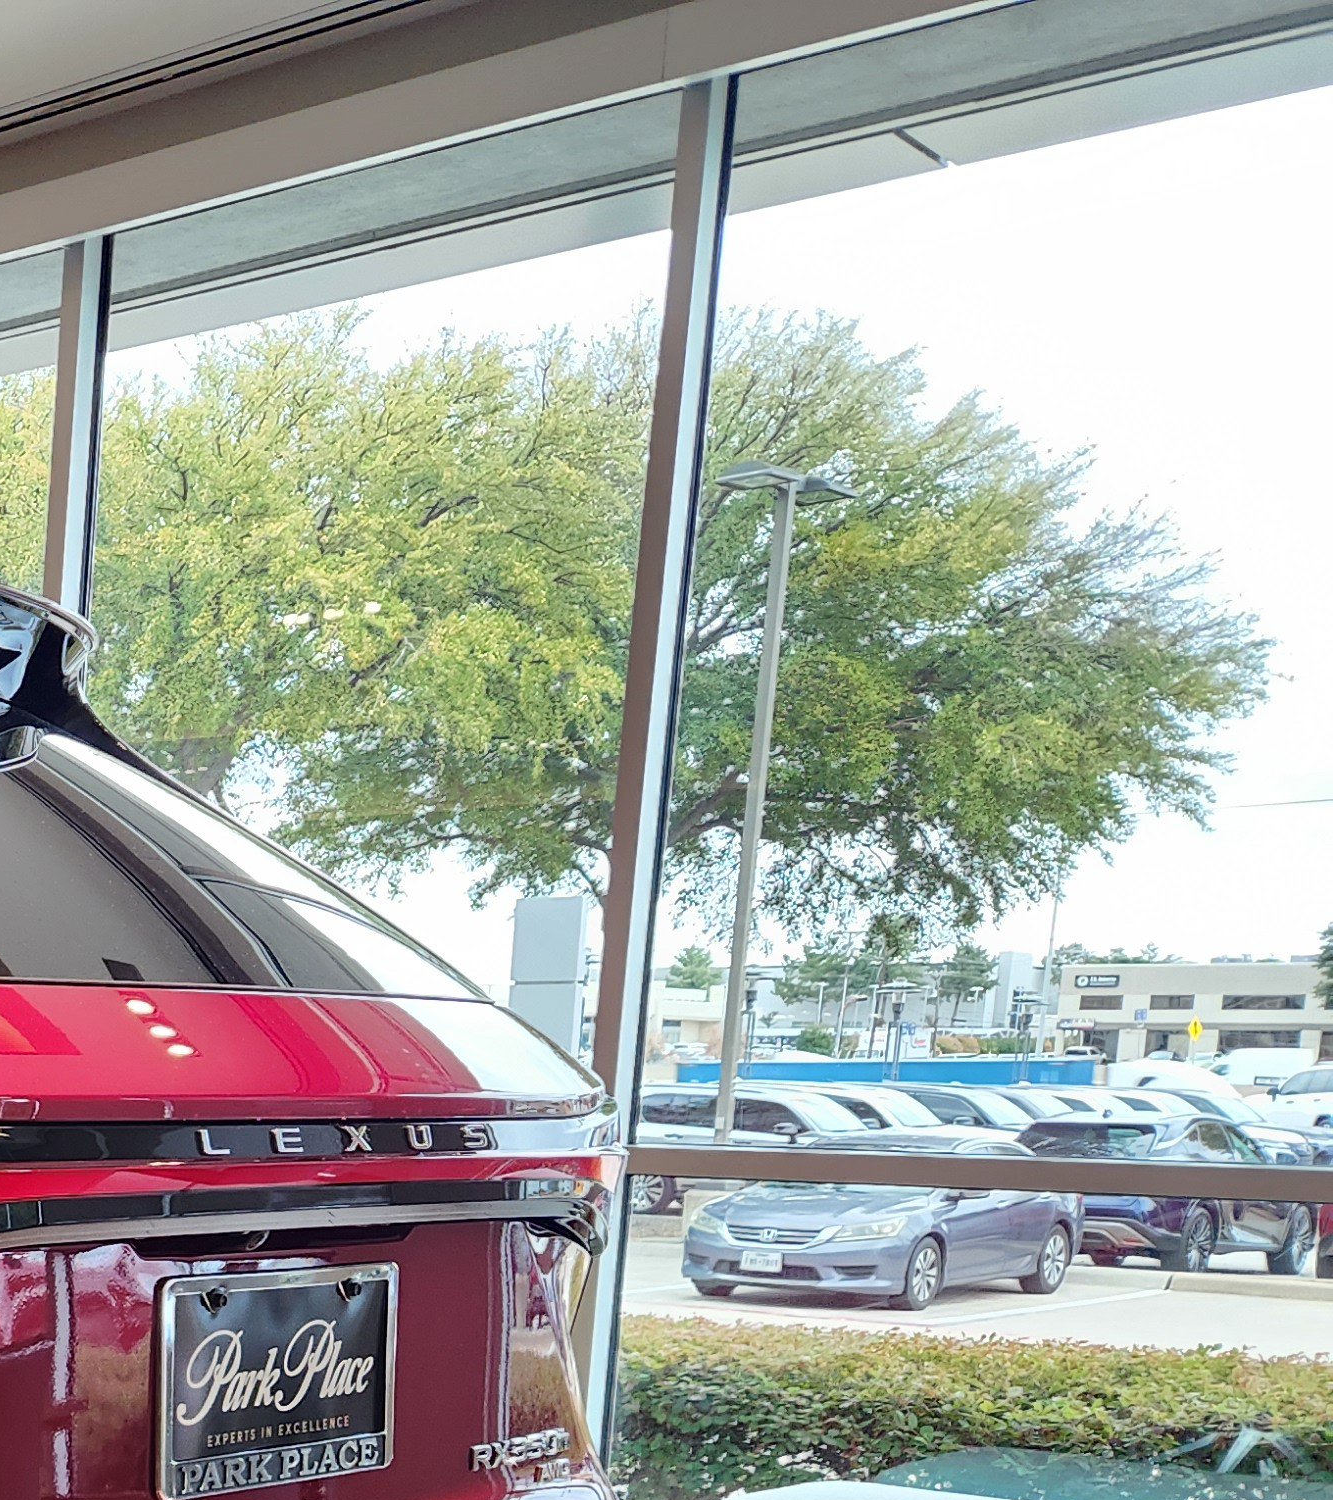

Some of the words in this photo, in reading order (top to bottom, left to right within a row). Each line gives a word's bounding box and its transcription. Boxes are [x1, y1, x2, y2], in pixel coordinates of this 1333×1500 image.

[196, 1124, 488, 1155] LEXUS
[176, 1329, 282, 1427] Park
[275, 1319, 375, 1412] Place
[207, 1428, 256, 1448] EXPERTS
[261, 1426, 273, 1438] IN
[278, 1414, 351, 1437] EXCELLENCE
[181, 1453, 273, 1495] PARK
[279, 1437, 379, 1479] PLACE
